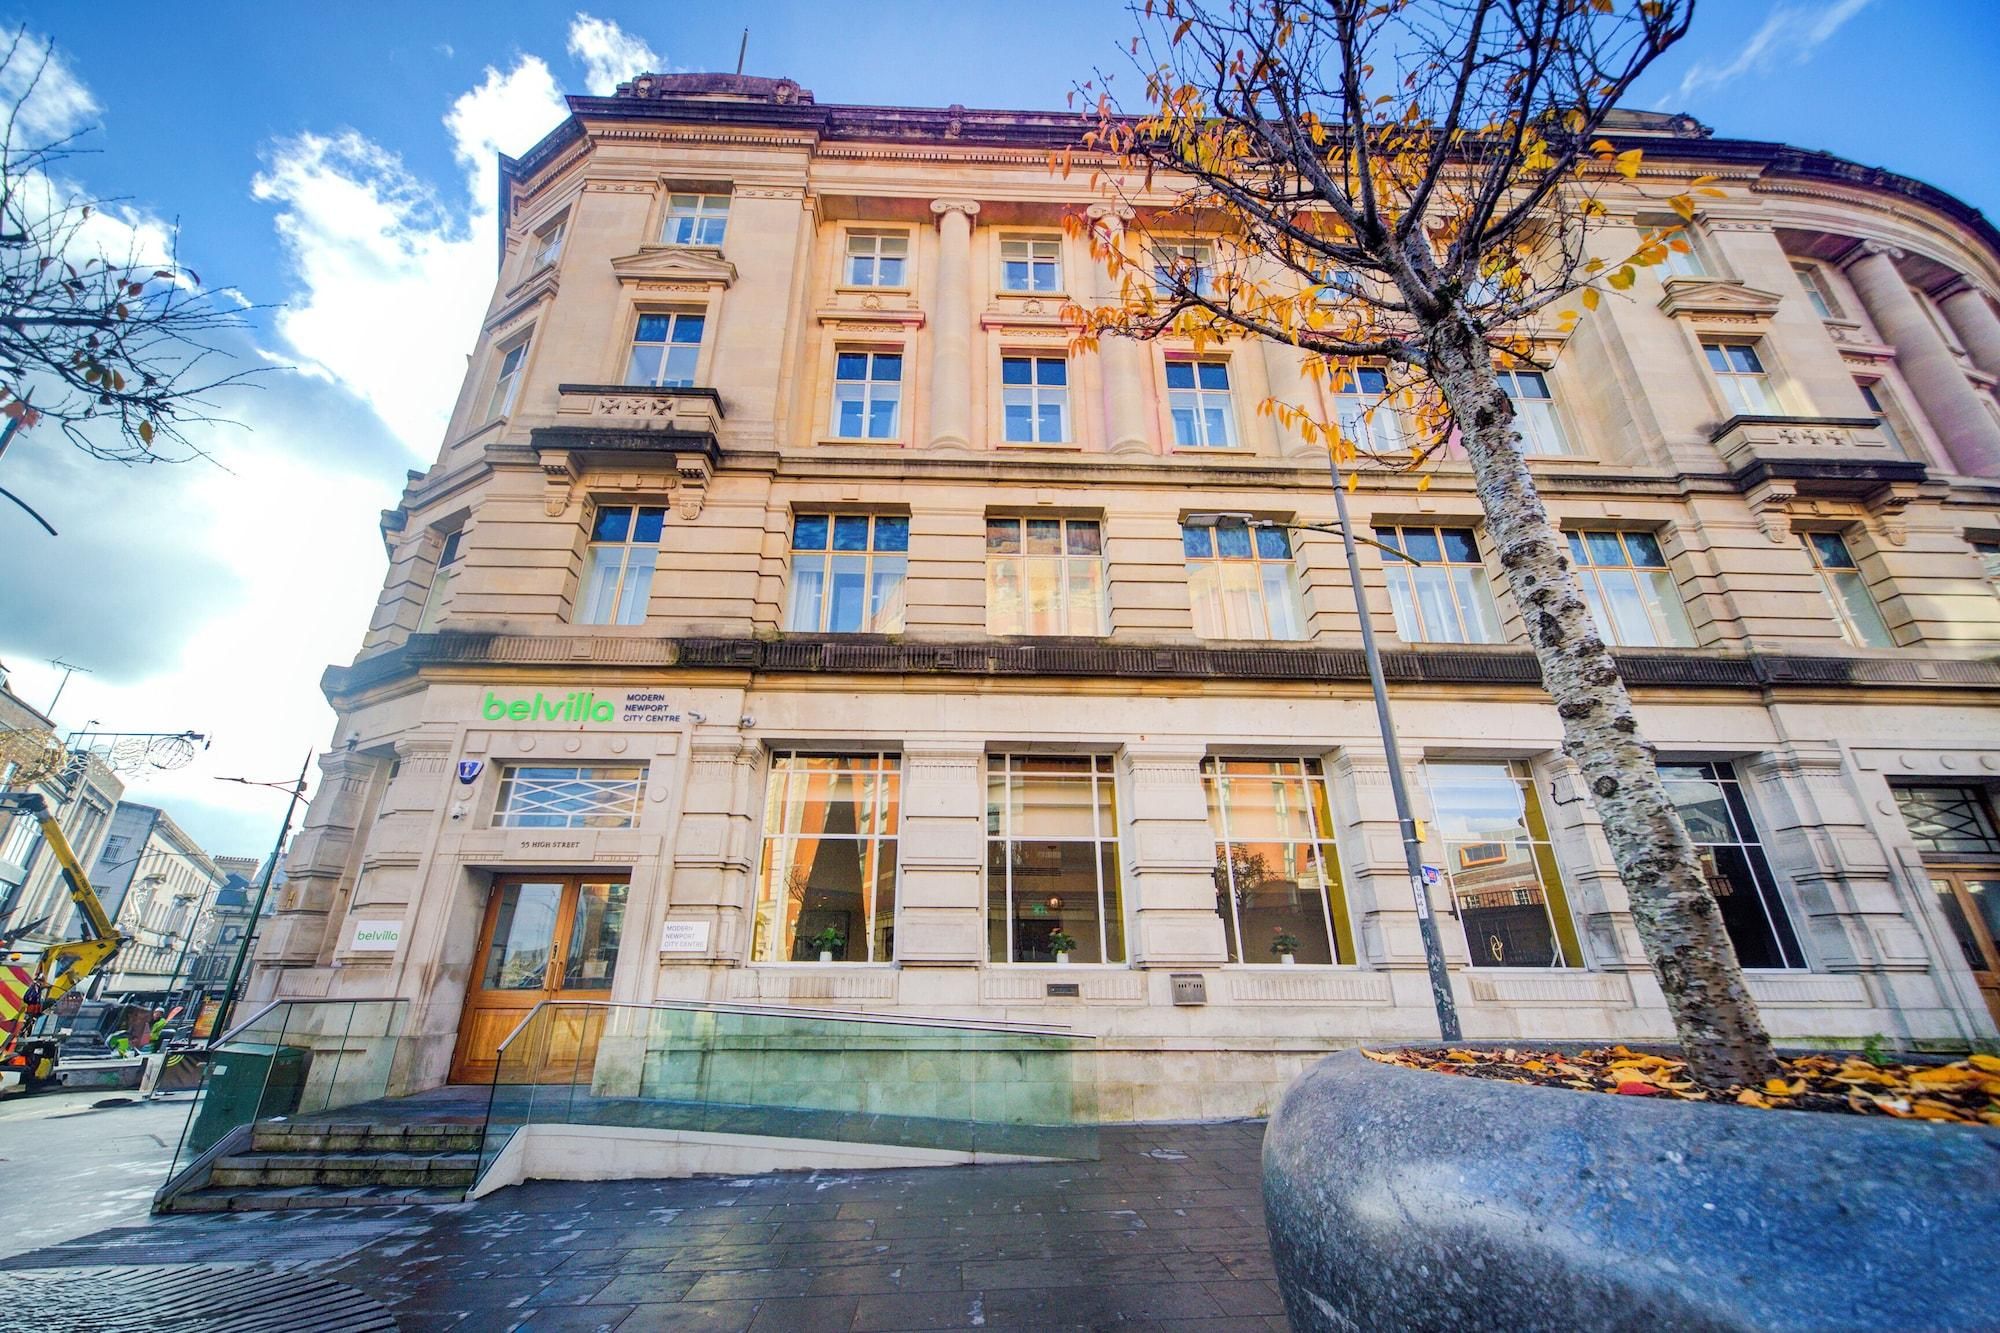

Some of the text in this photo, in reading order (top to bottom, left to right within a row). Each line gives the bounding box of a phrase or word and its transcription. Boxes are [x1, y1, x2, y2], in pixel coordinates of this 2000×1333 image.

[626, 694, 665, 702] MODERN
[482, 691, 615, 723] belvilla
[625, 704, 669, 712] NEWPORT
[623, 714, 681, 722] CITY CENTRE
[357, 930, 398, 941] belvilla
